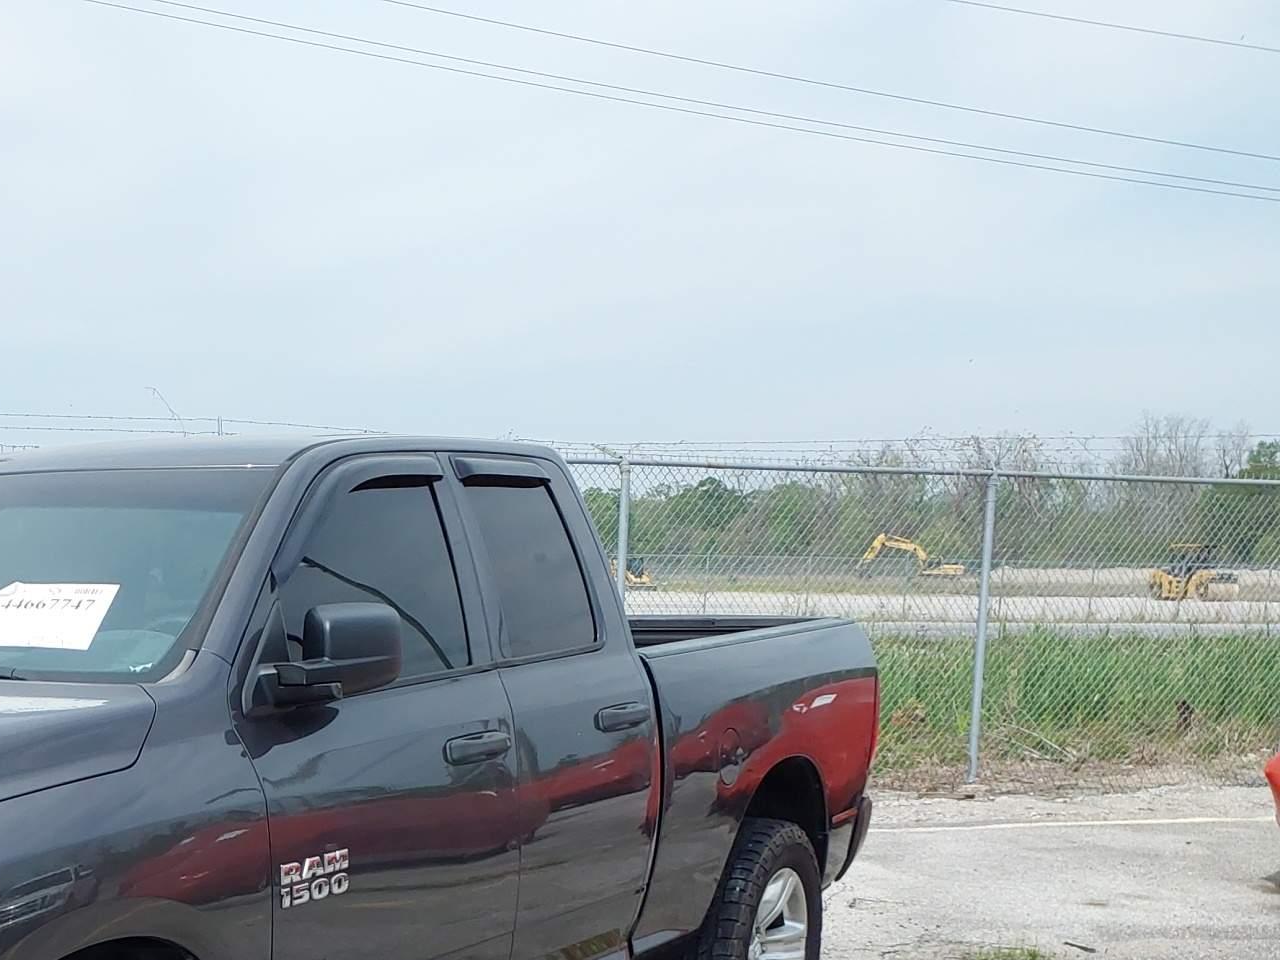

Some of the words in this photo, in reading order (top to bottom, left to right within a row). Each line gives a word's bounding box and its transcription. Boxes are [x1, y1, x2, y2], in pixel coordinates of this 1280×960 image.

[0, 598, 97, 610] 44667747
[280, 848, 349, 886] RAM
[281, 872, 349, 909] 1500
